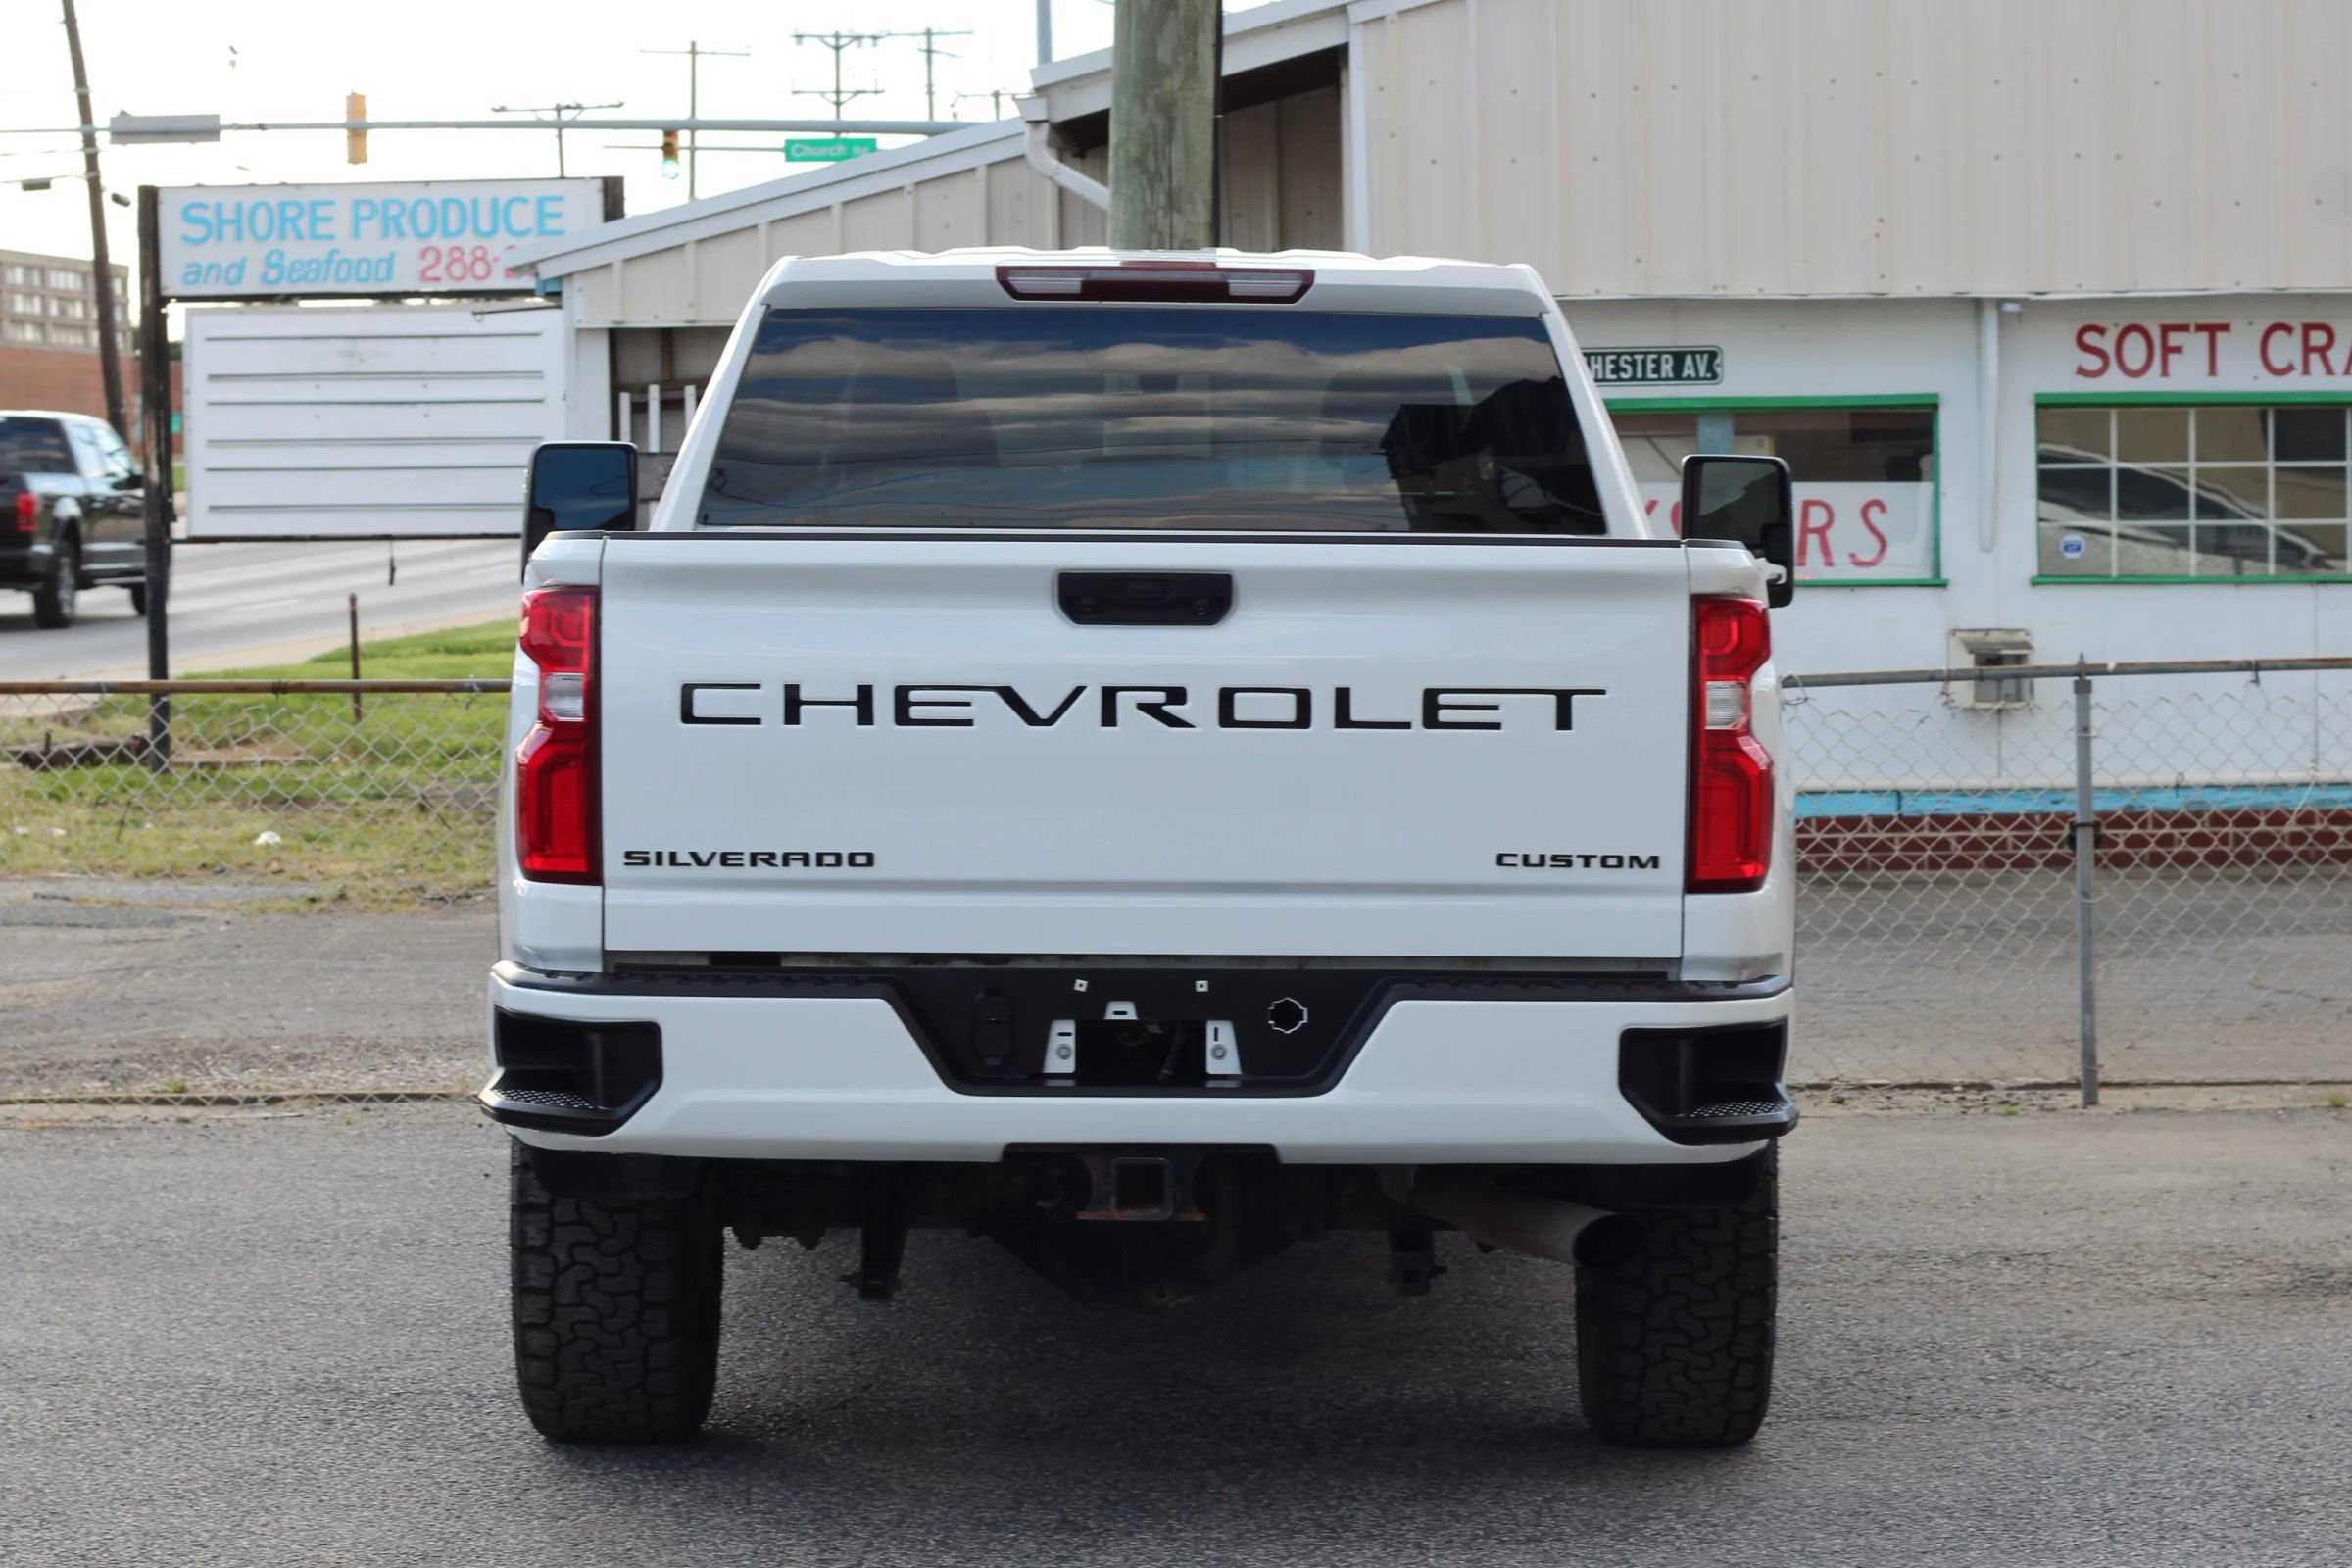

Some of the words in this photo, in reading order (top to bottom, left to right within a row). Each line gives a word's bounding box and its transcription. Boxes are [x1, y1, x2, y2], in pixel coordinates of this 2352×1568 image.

[180, 199, 336, 245] SHORE
[351, 195, 566, 240] PRODUCE
[182, 258, 248, 287] and
[260, 248, 396, 286] Seafood
[1583, 354, 1674, 380] HESTER
[2075, 322, 2231, 378] SOFT
[2259, 320, 2352, 377] CR
[680, 683, 1606, 731] CHEVROLET
[624, 850, 875, 868] SILVERADO
[1495, 853, 1660, 869] CUSTOM
